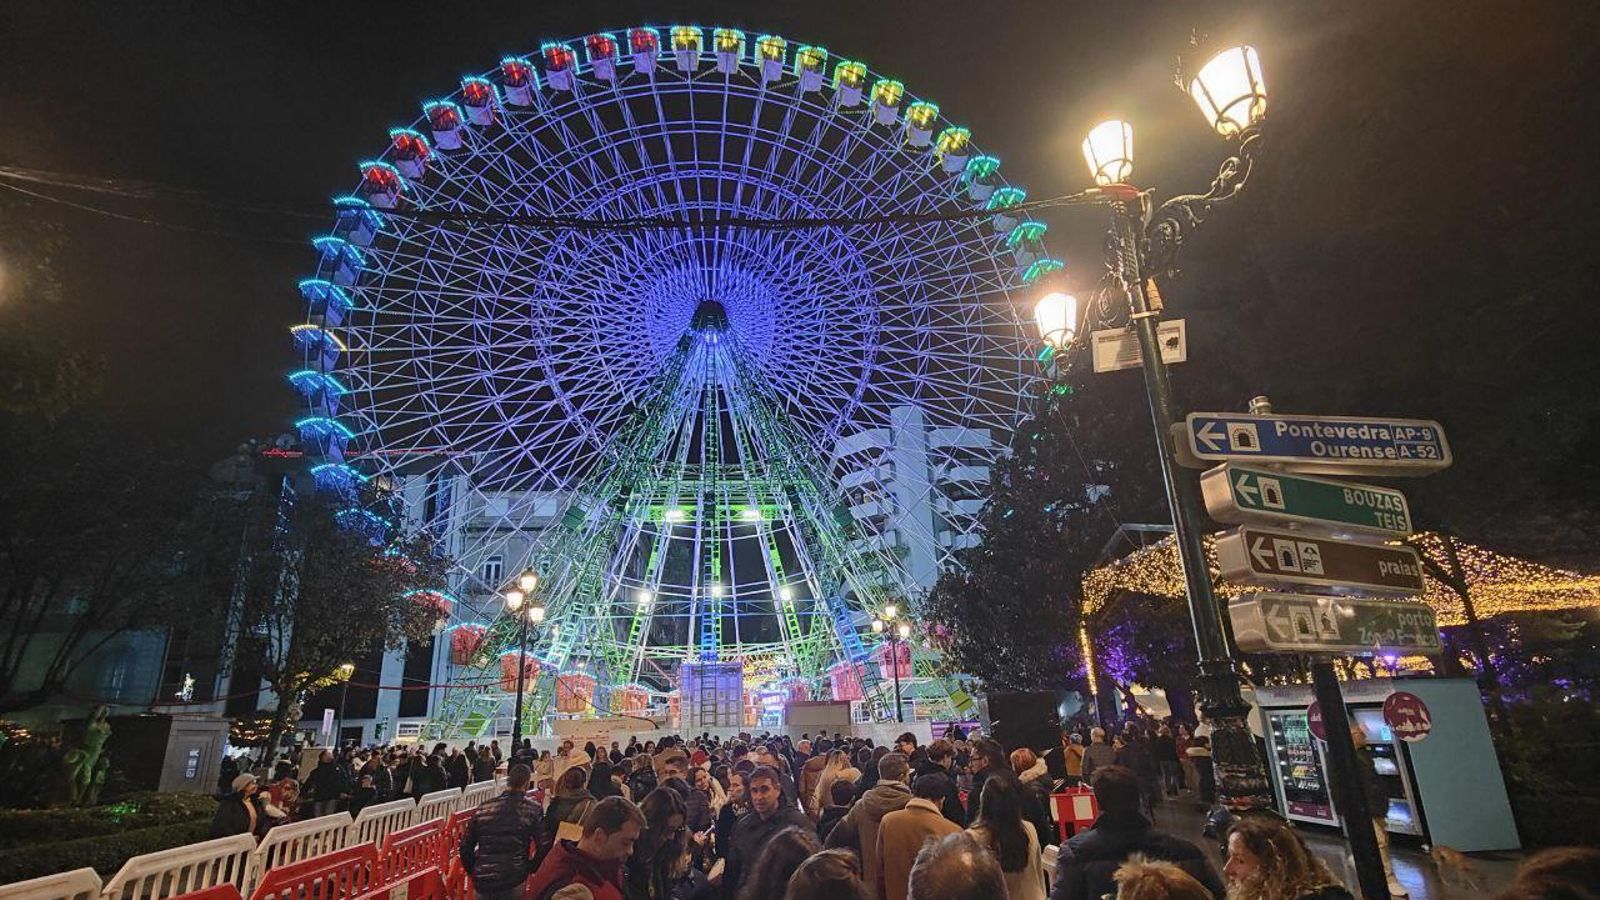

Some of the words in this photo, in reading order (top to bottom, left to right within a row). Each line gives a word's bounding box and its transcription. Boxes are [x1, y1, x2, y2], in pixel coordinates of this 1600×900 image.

[1274, 421, 1391, 441] Pontevedra
[1395, 428, 1433, 441] AP-9
[1310, 440, 1396, 459] Ourense
[1400, 444, 1437, 459] A-52
[1343, 488, 1403, 512] BOUZAS
[1374, 511, 1407, 531] TEIS
[1378, 559, 1418, 577] praias
[1398, 610, 1432, 629] porto
